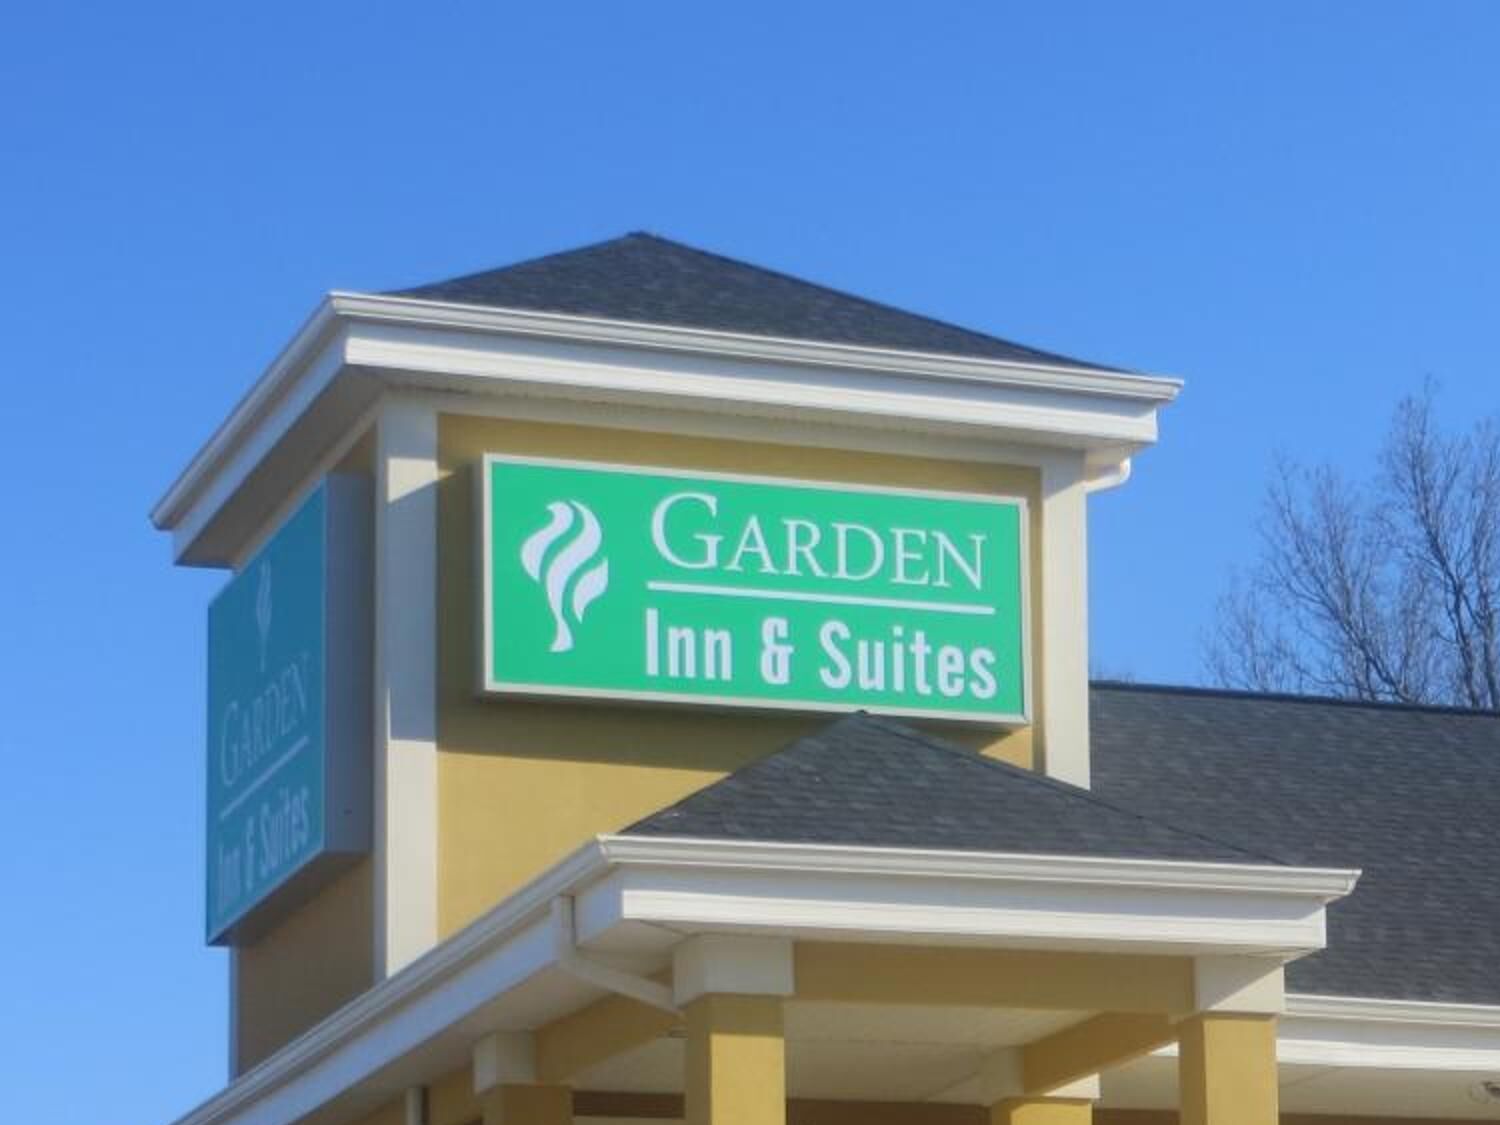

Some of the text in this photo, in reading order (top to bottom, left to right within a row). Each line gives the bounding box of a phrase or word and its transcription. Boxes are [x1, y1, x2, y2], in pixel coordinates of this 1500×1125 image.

[651, 491, 987, 591] GARDEN
[646, 607, 998, 699] Inn & Suites
[220, 651, 312, 787] GARDEN
[258, 785, 310, 878] Suites
